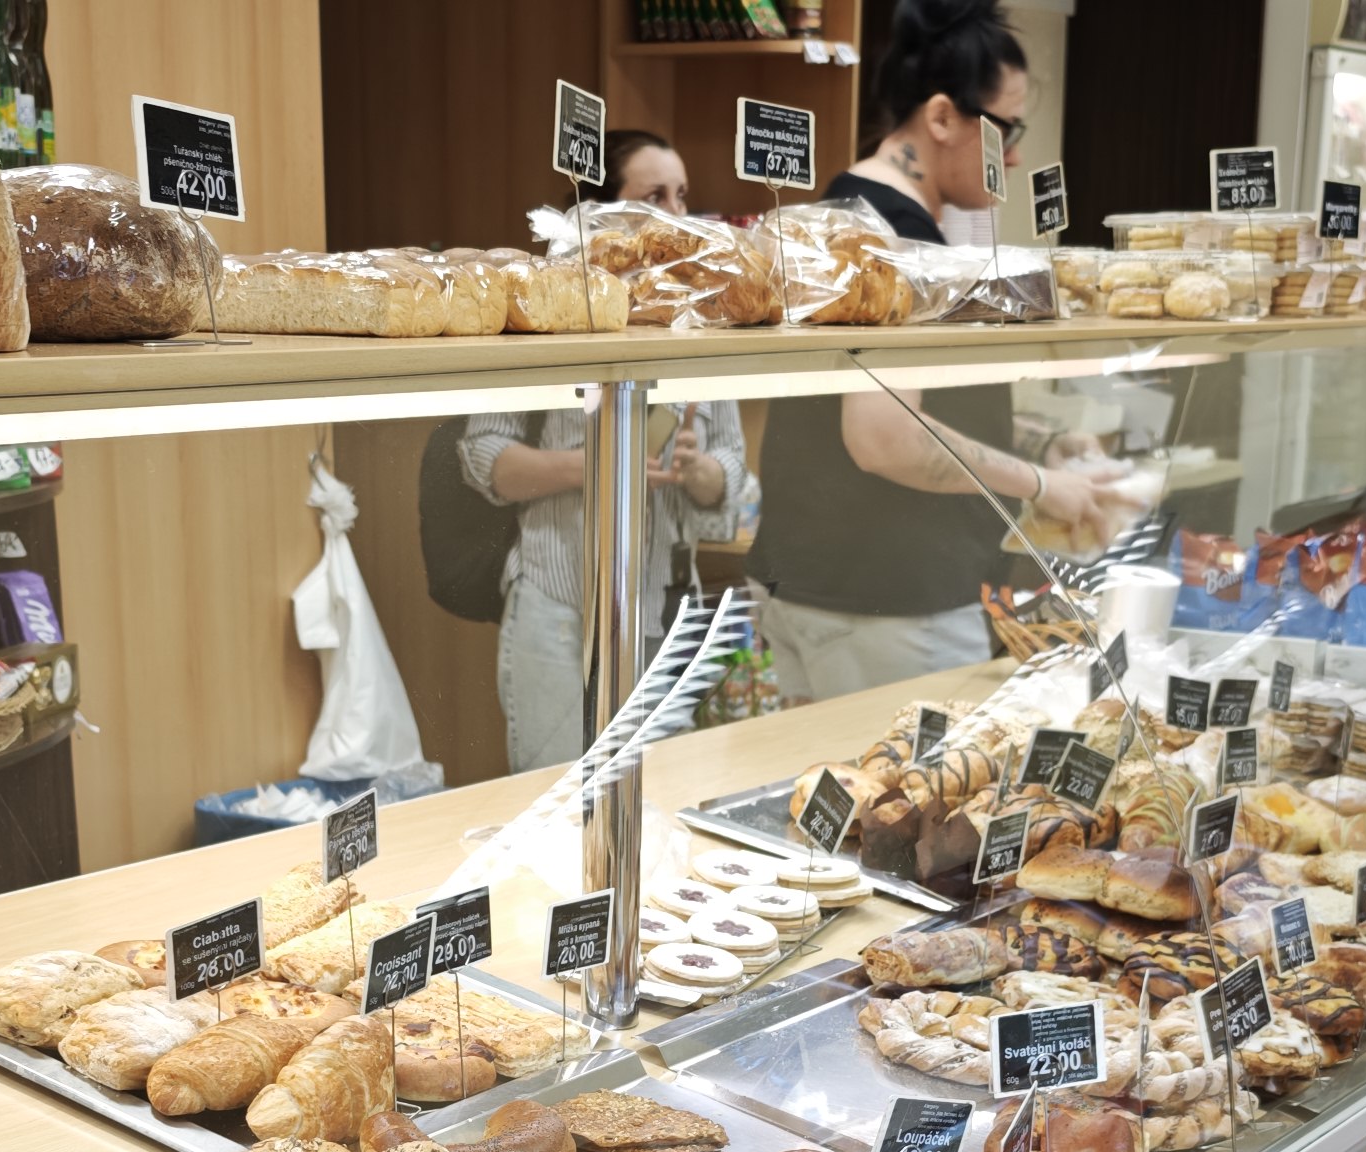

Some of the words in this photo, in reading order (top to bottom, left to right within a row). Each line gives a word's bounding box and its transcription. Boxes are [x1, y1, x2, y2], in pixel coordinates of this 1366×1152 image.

[176, 170, 227, 202] 42,00
[181, 957, 191, 966] se
[193, 942, 228, 962] sušenými
[229, 931, 253, 947] rajčaty
[192, 923, 240, 949] Ciabatta
[435, 934, 477, 966] 29,00
[197, 948, 245, 982] 28,00
[375, 945, 423, 977] Croissant
[1004, 1042, 1056, 1059] Svatební
[1059, 1037, 1091, 1051] koláč
[1027, 1050, 1082, 1077] 22,00
[1006, 1077, 1020, 1086] 60g
[896, 1128, 952, 1148] Loupáček
